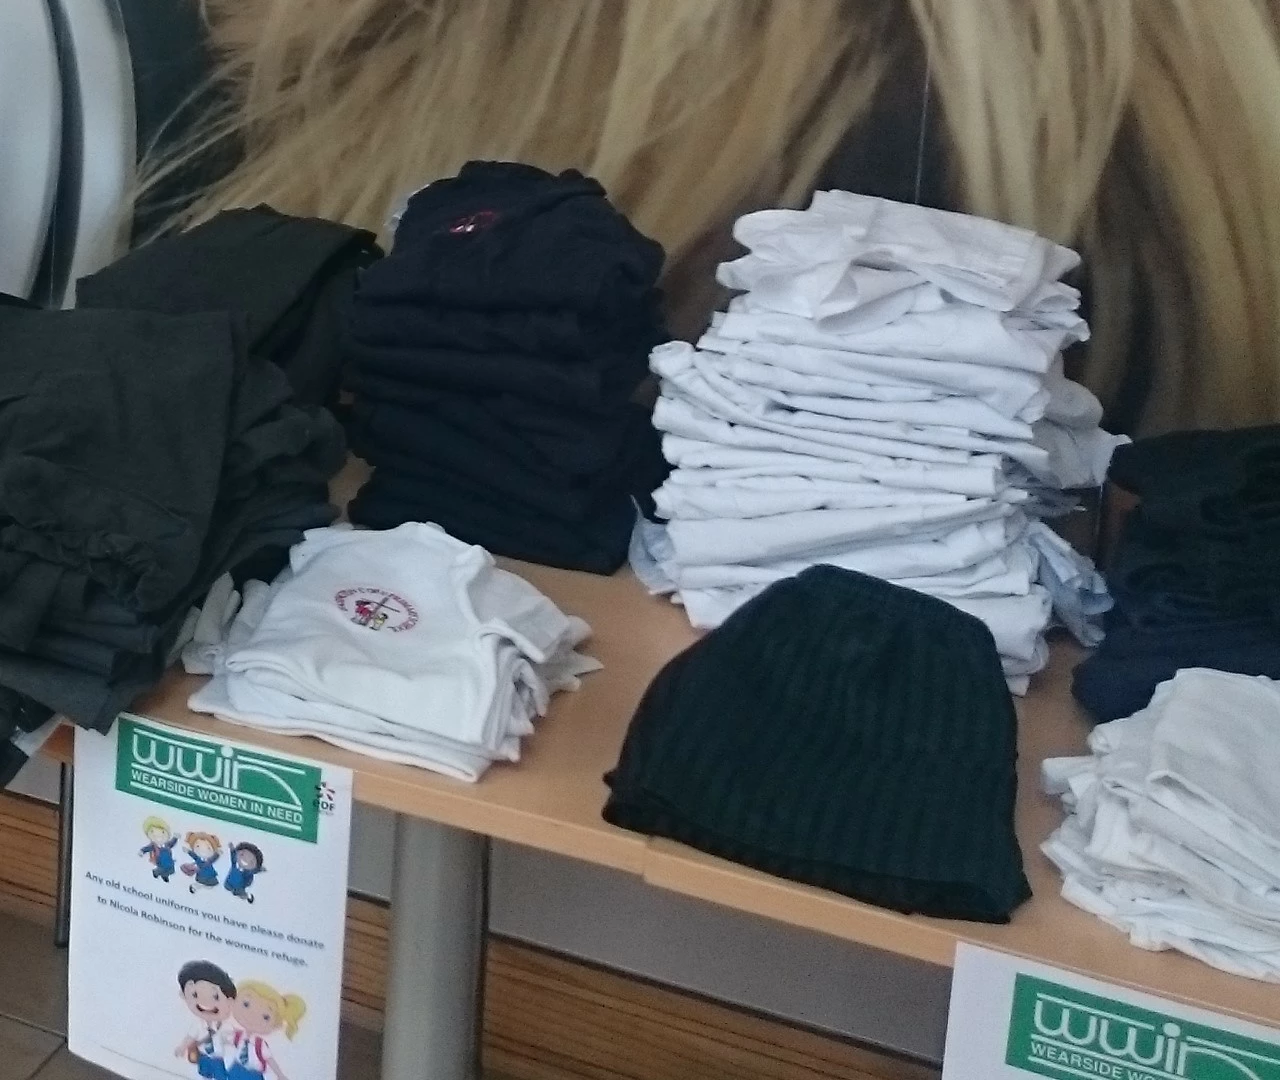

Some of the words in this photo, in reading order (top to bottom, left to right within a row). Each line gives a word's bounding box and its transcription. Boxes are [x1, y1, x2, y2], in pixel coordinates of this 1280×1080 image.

[131, 769, 195, 798] WEARSIDE
[198, 788, 247, 812] WOMEN
[250, 801, 263, 814] IN
[268, 806, 302, 823] NEED
[85, 871, 103, 885] Any
[105, 879, 120, 890] old
[123, 884, 153, 900] school
[155, 896, 199, 916] uniforms
[202, 911, 220, 922] you
[223, 915, 248, 929] have
[250, 925, 285, 940] please
[286, 933, 325, 950] donate
[97, 895, 107, 904] to
[109, 899, 139, 916] Nicola
[141, 910, 186, 932] Robinson
[188, 926, 202, 937] for
[206, 932, 222, 943] the
[225, 938, 269, 957] womens
[1030, 1041, 1122, 1079] WEARSIDE
